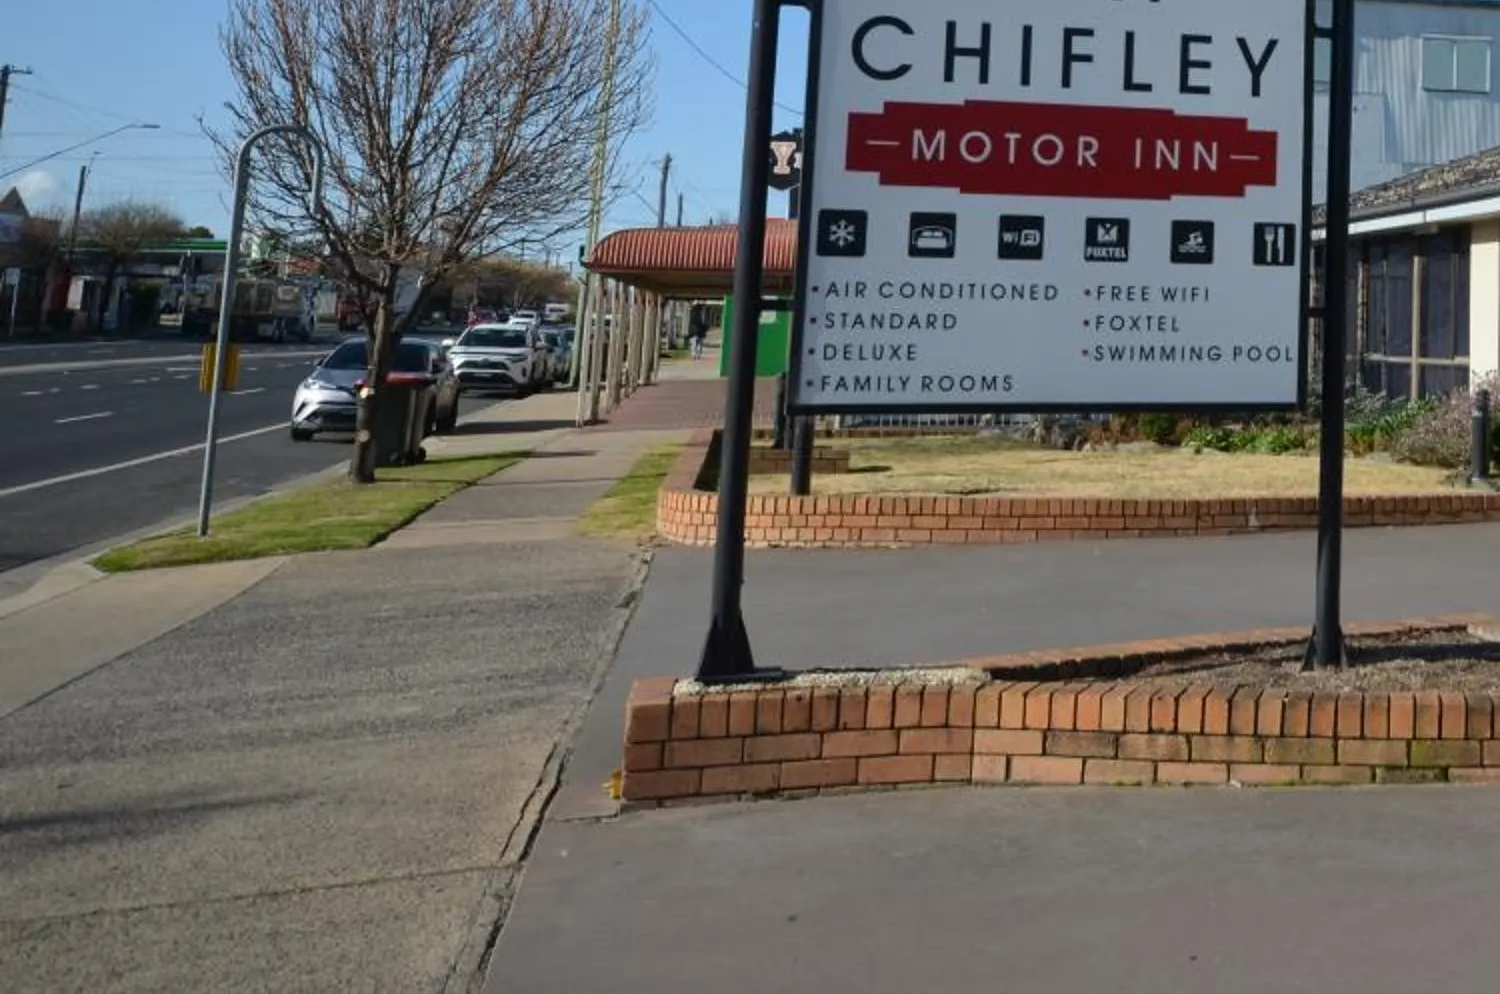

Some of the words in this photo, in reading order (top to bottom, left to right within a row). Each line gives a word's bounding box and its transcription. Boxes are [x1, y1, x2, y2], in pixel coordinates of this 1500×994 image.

[850, 15, 1279, 98] CHIFLEY
[910, 128, 1099, 168] MOTOR
[1134, 137, 1219, 172] INN
[825, 281, 868, 299] AIR
[878, 282, 1059, 301] CONDITIONED
[1096, 285, 1151, 302] FREE
[1161, 286, 1211, 303] WIFI
[824, 312, 958, 331] STANDARD
[1095, 315, 1180, 333] FOXTEL
[822, 343, 918, 362] DELUXE
[1093, 345, 1223, 363] SWIMMING
[1233, 346, 1294, 363] POOL
[820, 375, 911, 394] FAMILY
[921, 375, 1015, 393] ROOMS
